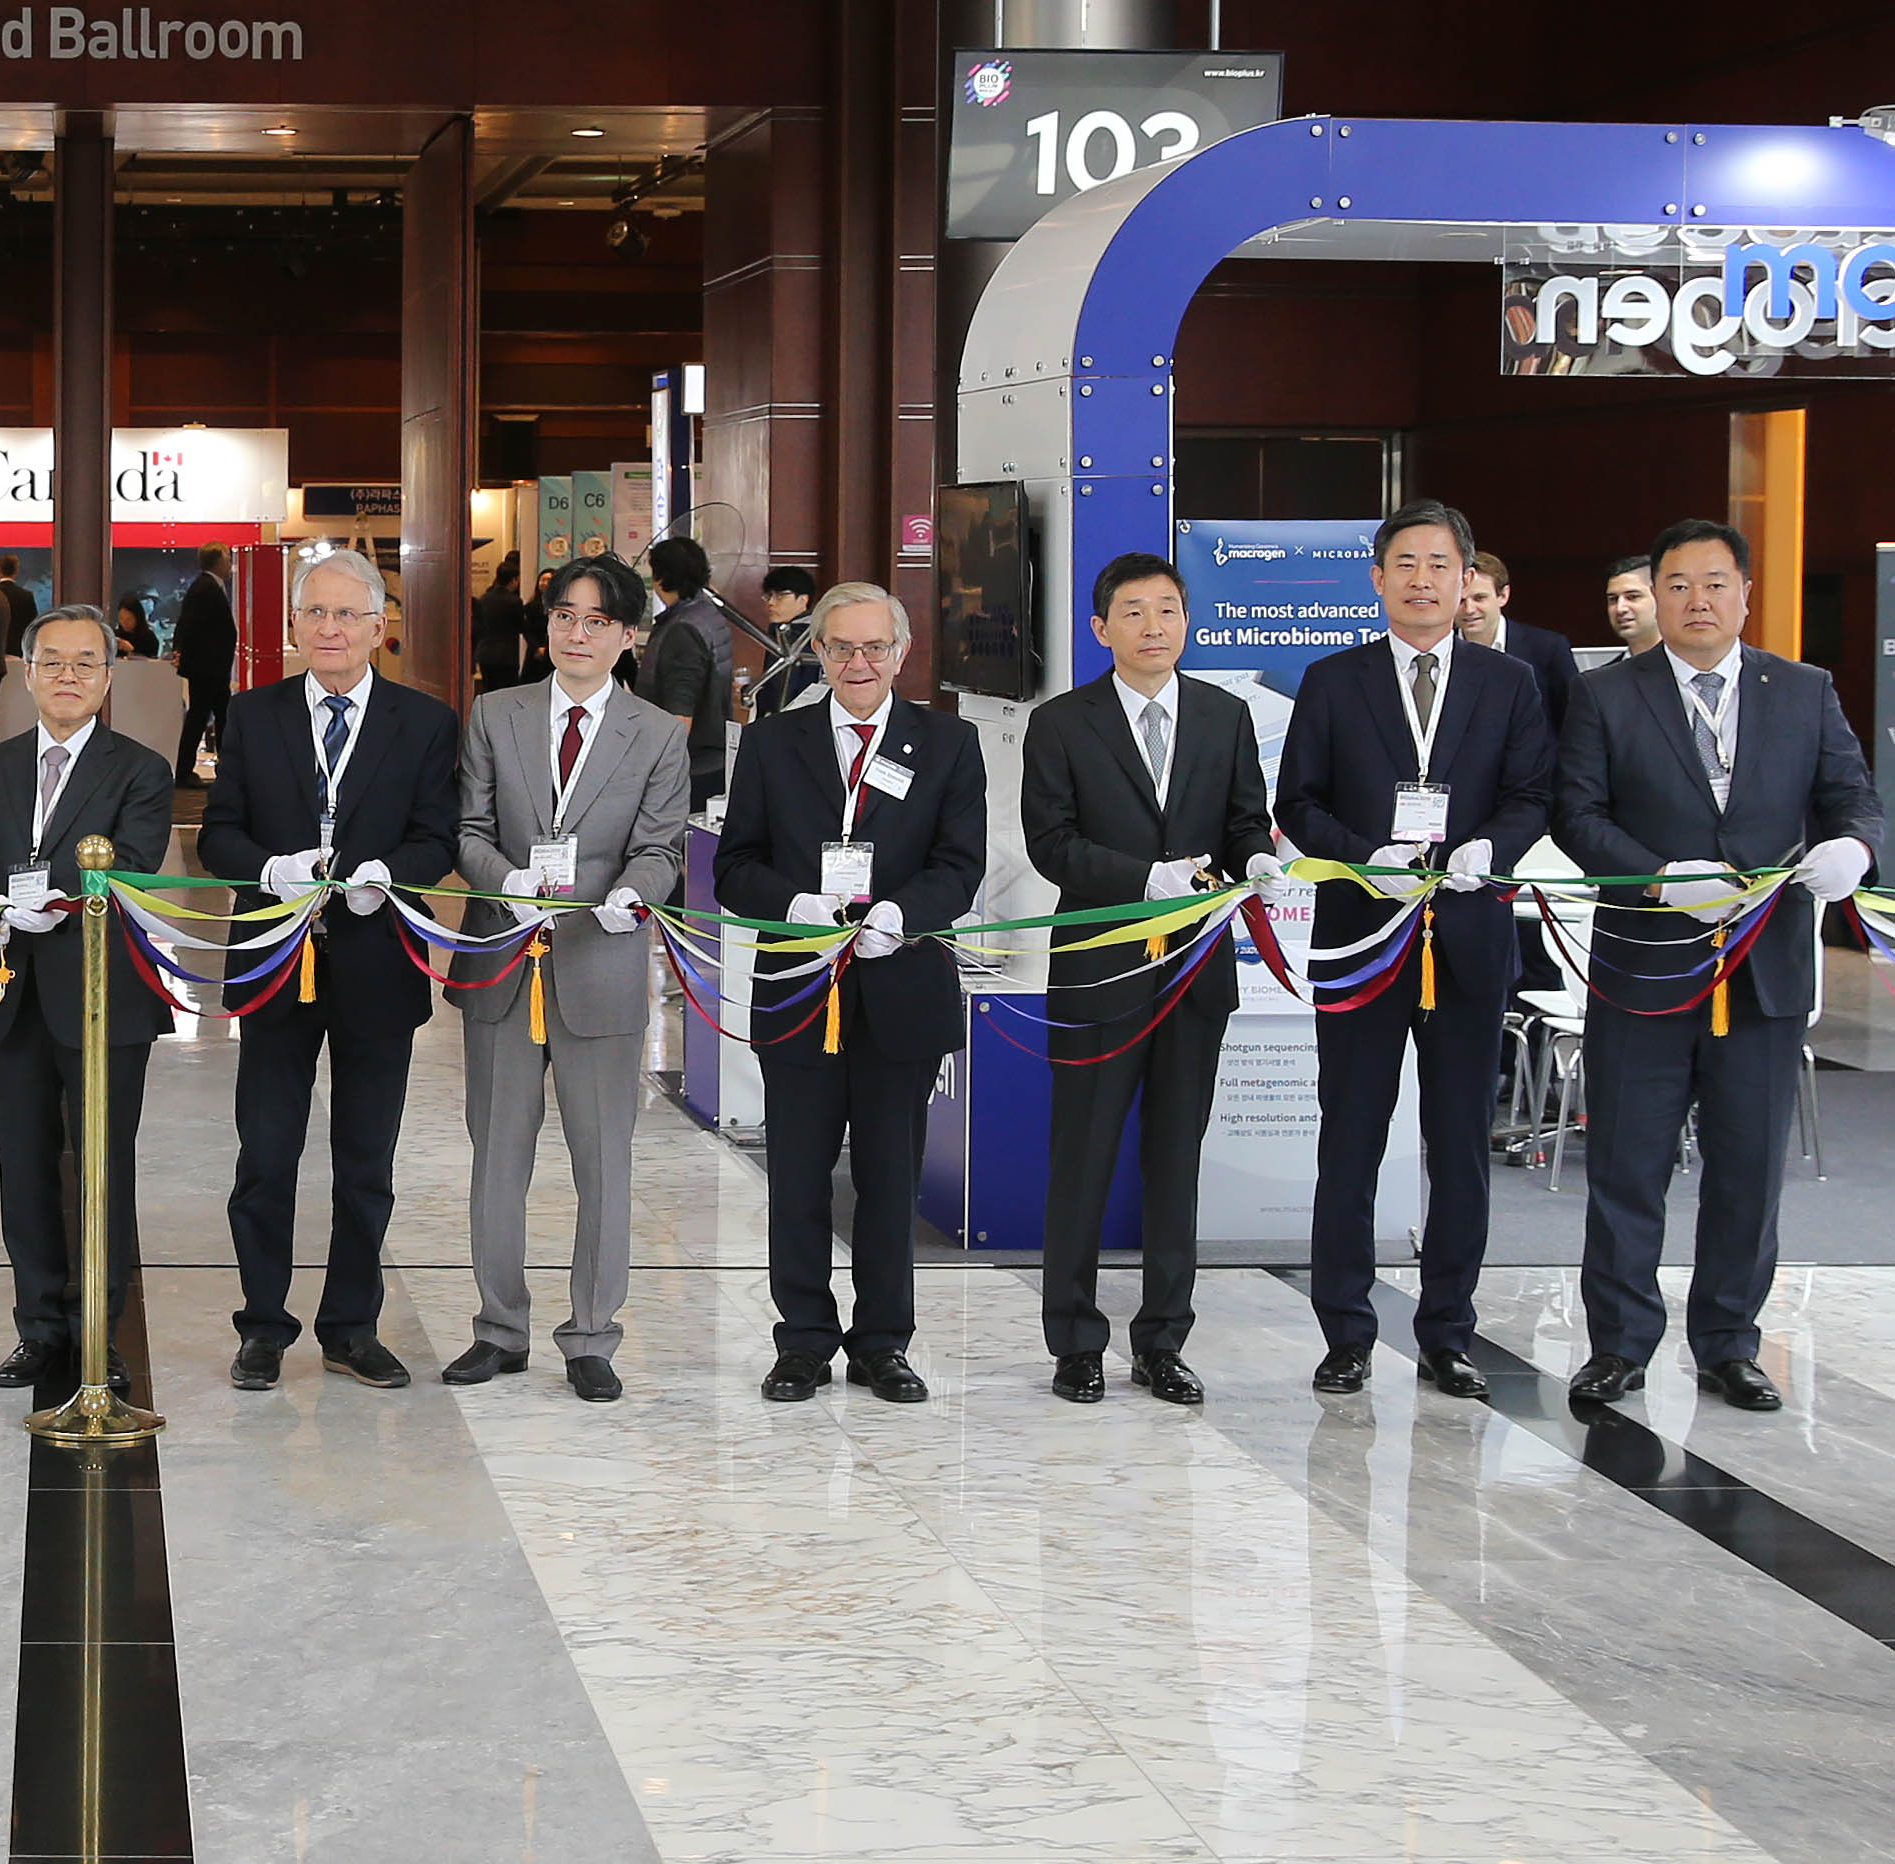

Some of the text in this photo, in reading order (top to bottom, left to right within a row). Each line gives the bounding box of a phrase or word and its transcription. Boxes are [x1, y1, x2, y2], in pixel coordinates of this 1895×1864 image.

[50, 6, 303, 60] Ballroom
[979, 74, 999, 84] BIO
[1203, 68, 1265, 79] www.bioplus.kr
[549, 496, 569, 510] D6
[584, 493, 605, 508] C6
[1229, 549, 1286, 561] macrogen
[1312, 549, 1368, 559] MICROBA
[1215, 601, 1379, 619] The most advanced
[1196, 628, 1232, 646] Gut
[1236, 627, 1354, 646] Microbiome
[1883, 638, 1895, 656] B
[1267, 906, 1313, 922] OME
[1219, 1042, 1319, 1054] Shotgun sequencing
[1220, 1078, 1238, 1087] Full
[1241, 1078, 1308, 1089] metagenomic
[1220, 1113, 1317, 1124] High resolution and
